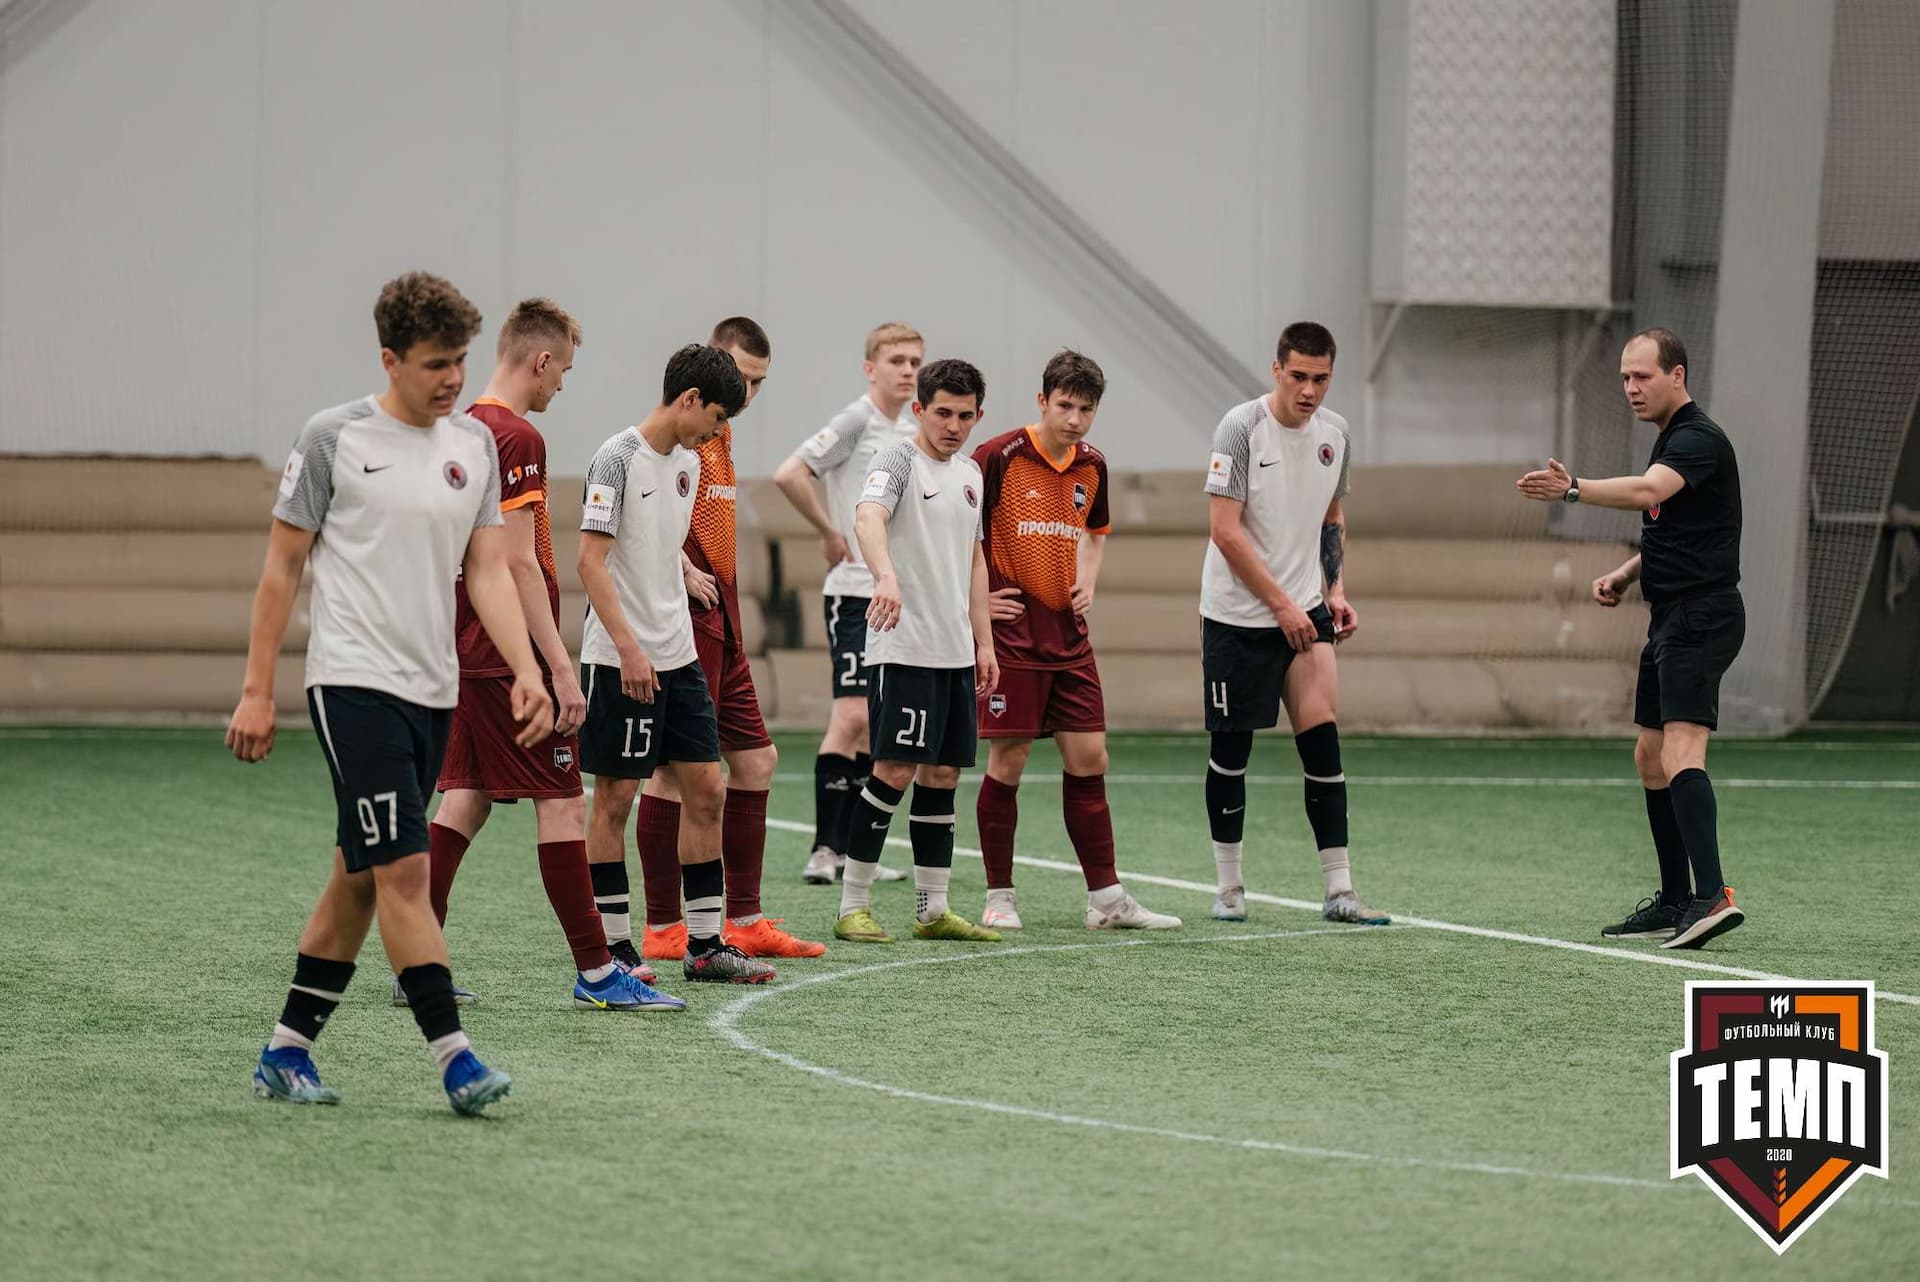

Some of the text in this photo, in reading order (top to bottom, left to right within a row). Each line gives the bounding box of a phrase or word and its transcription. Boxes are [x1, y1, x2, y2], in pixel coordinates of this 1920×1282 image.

[1211, 680, 1229, 717] 4
[621, 717, 654, 758] 15
[895, 706, 927, 748] 21
[356, 790, 398, 847] 97
